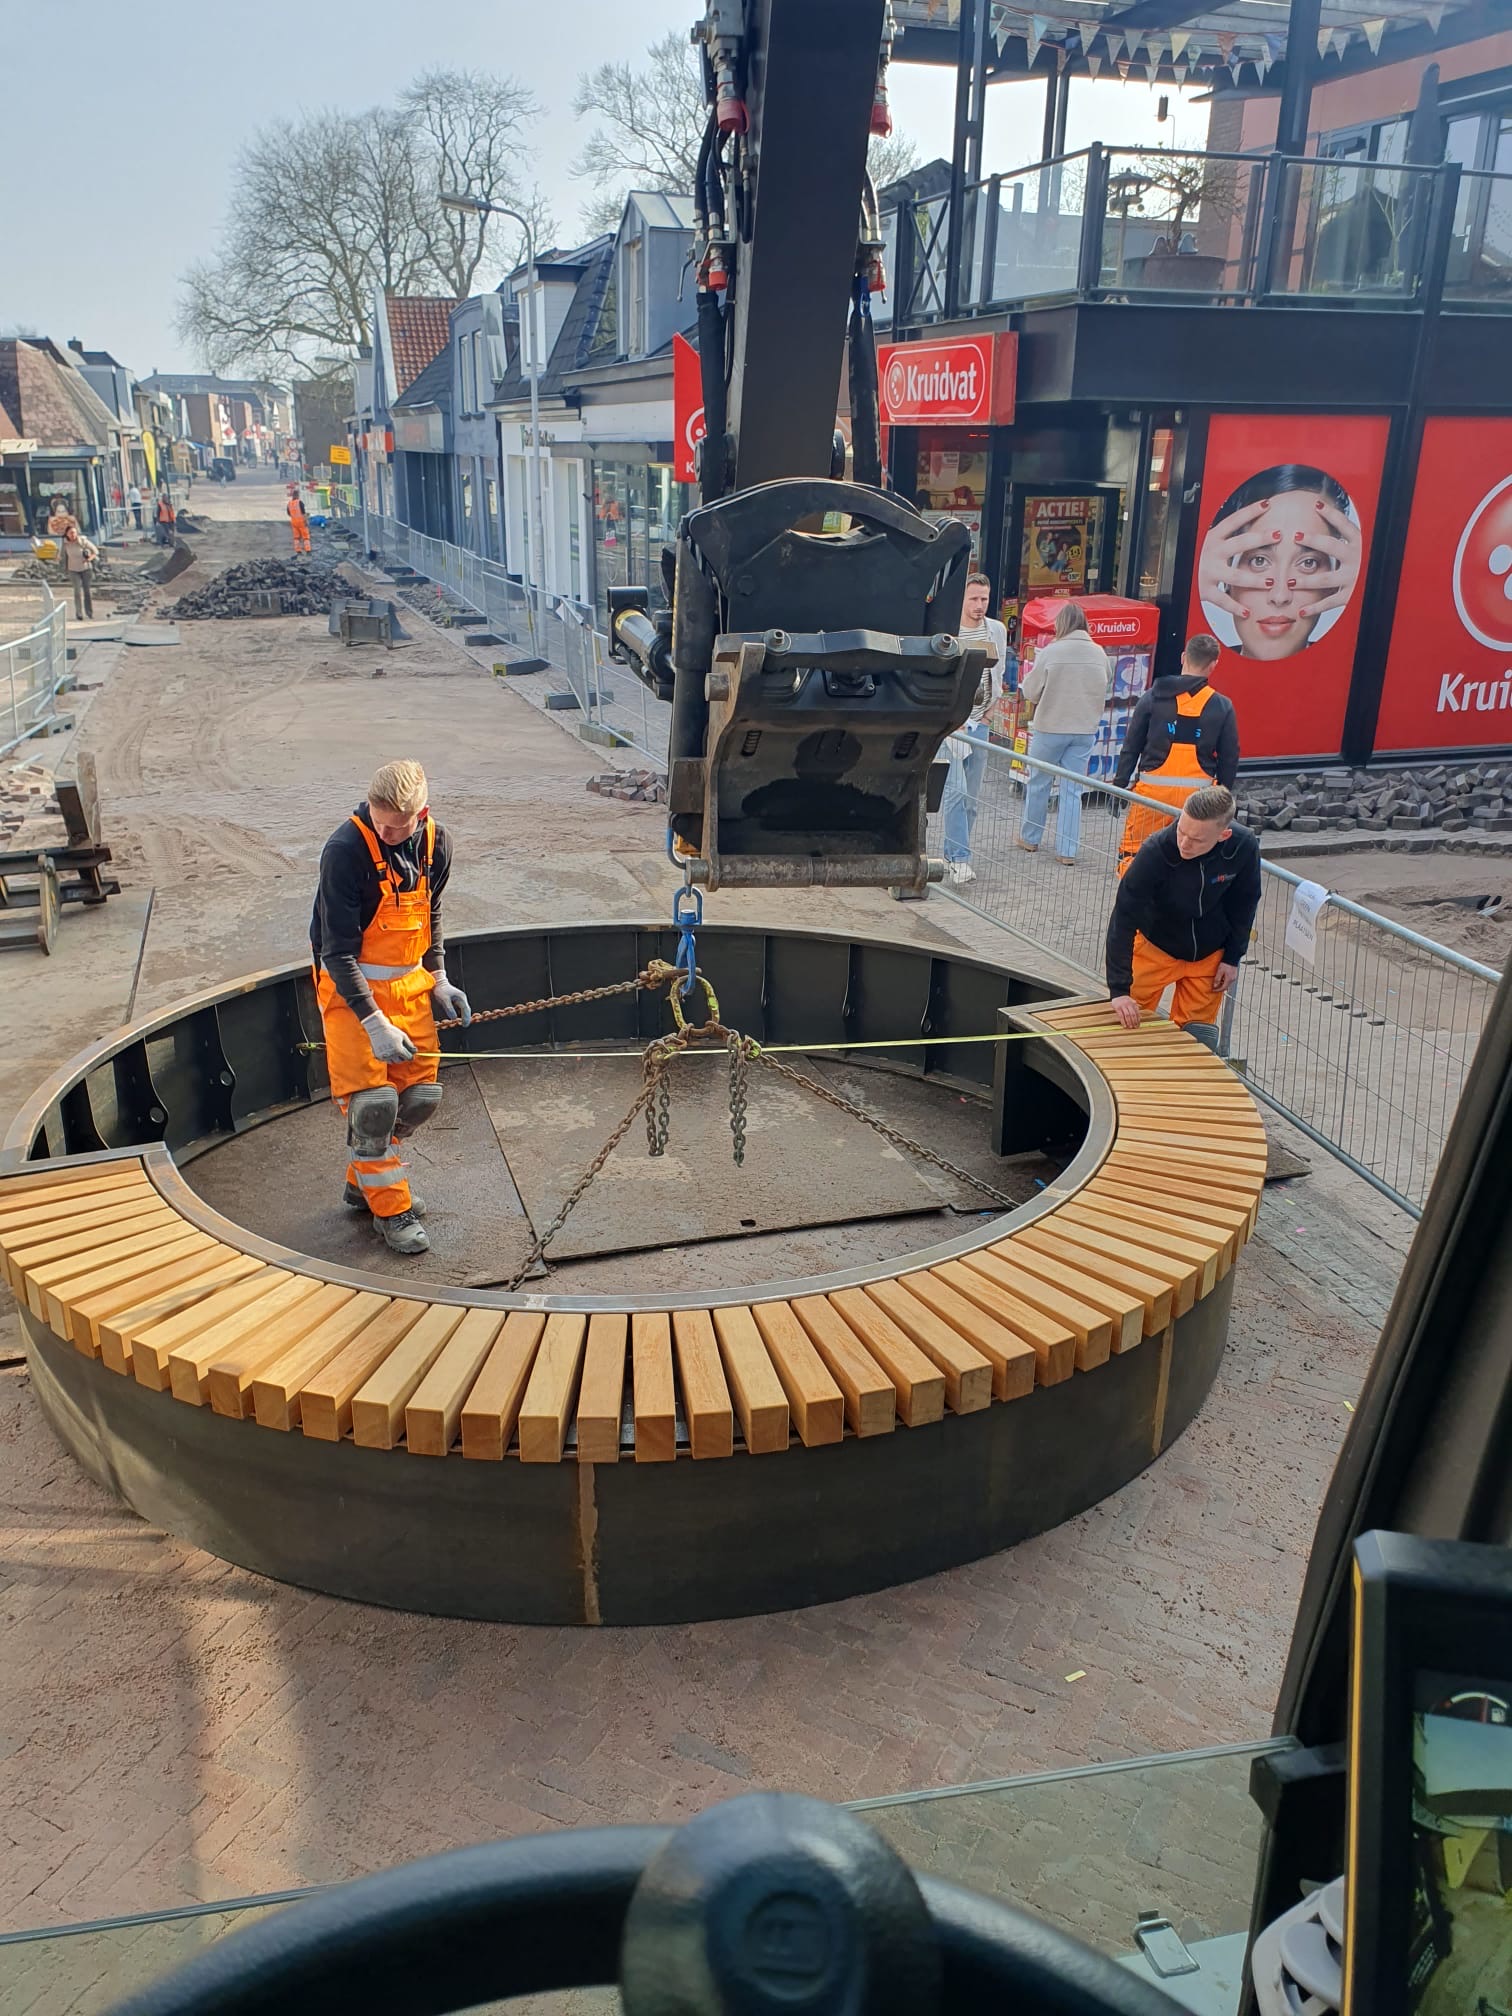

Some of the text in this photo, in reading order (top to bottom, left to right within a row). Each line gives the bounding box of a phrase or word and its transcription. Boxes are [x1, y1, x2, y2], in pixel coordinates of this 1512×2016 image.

[907, 360, 977, 401] Kruidvat
[1037, 501, 1084, 517] ACTIE!
[1096, 621, 1136, 633] Kruidvat
[1436, 668, 1512, 712] Krui
